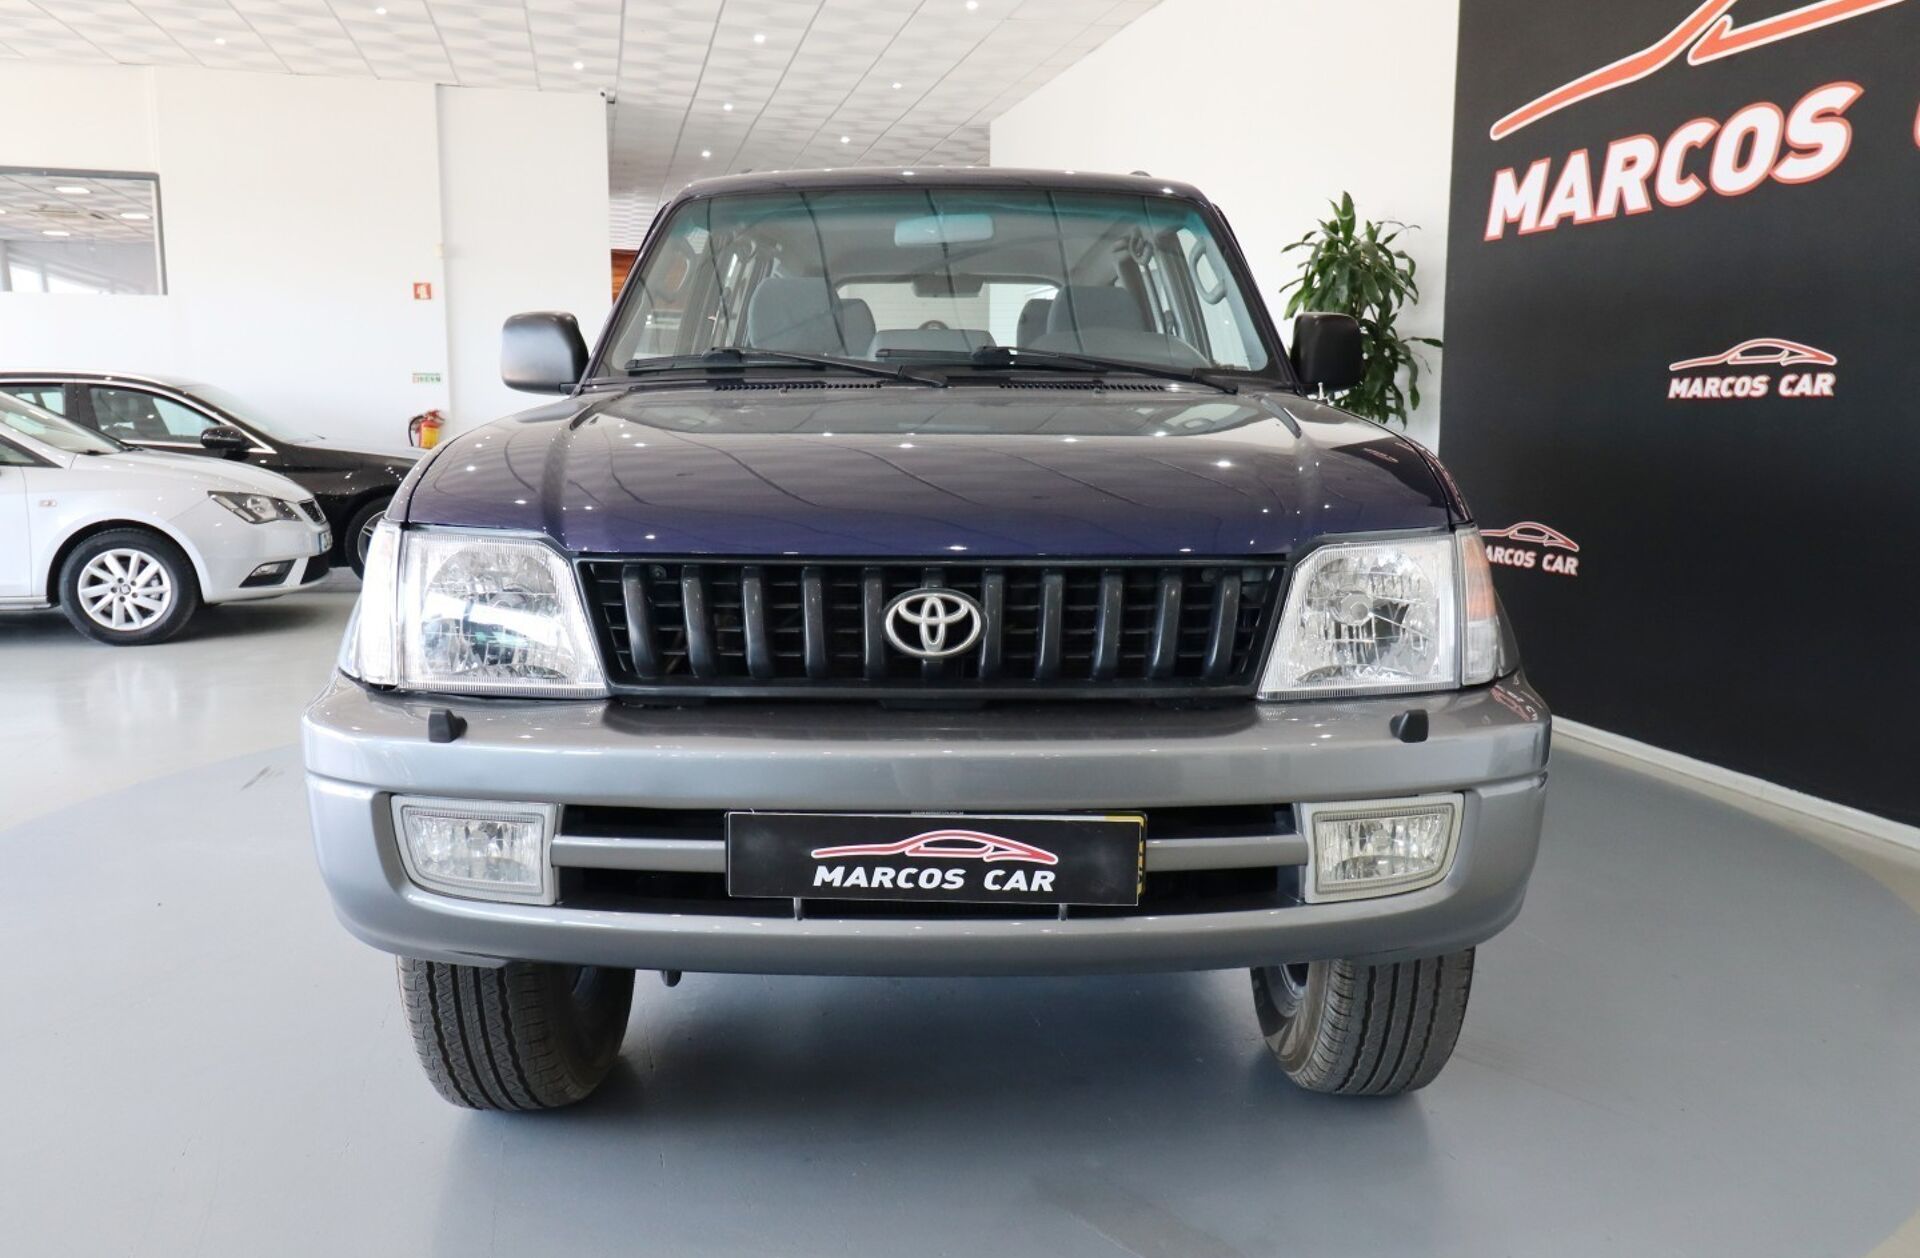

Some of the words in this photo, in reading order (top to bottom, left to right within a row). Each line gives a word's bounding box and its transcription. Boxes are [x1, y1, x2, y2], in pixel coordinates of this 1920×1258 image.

[1484, 81, 1864, 241] MARCOS
[1667, 374, 1770, 399] MARCOS
[1778, 371, 1836, 397] CAR
[1485, 544, 1536, 569] ARCOS
[1542, 553, 1579, 577] CAR
[813, 865, 964, 890] MARCOS
[983, 869, 1056, 893] CAR
